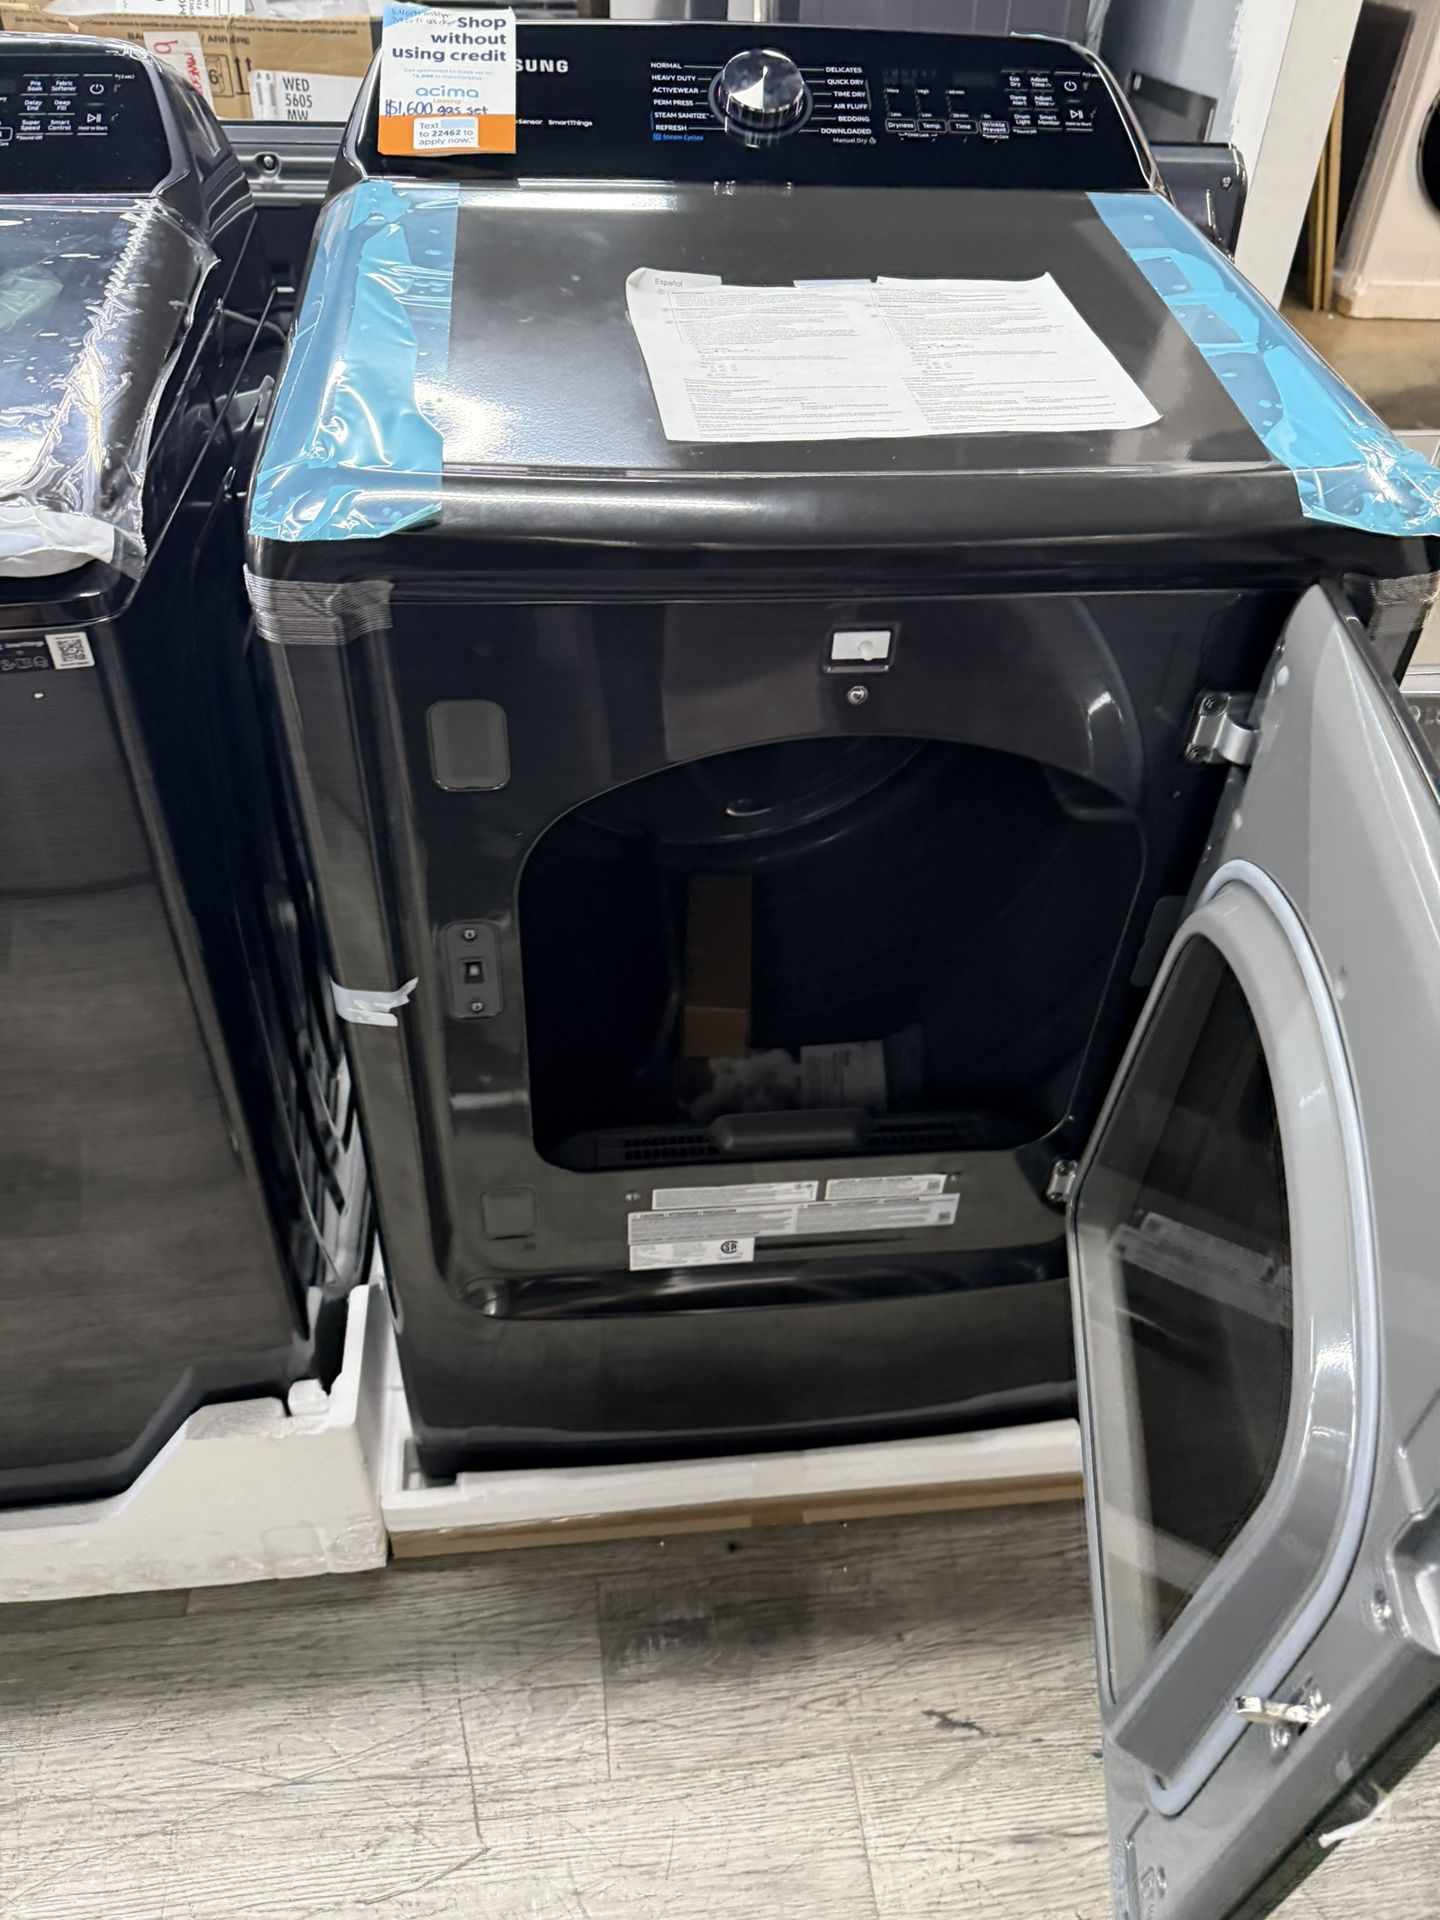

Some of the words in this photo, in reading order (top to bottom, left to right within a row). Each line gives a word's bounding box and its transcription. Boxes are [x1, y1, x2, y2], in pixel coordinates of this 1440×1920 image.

[457, 17, 507, 30] Shop
[431, 33, 507, 45] without
[392, 47, 445, 63] using
[449, 50, 507, 62] credit
[650, 62, 682, 70] NORMAL
[282, 77, 311, 92] WED
[415, 85, 480, 98] acima
[285, 93, 313, 108] 5605
[287, 109, 309, 121] MW
[420, 122, 440, 130] Text
[548, 119, 593, 128] SmartThings
[655, 124, 688, 132] REFRESH
[888, 122, 914, 130] Dryness
[432, 130, 461, 138] 22462
[419, 138, 446, 146] apply
[654, 278, 683, 288] Español
